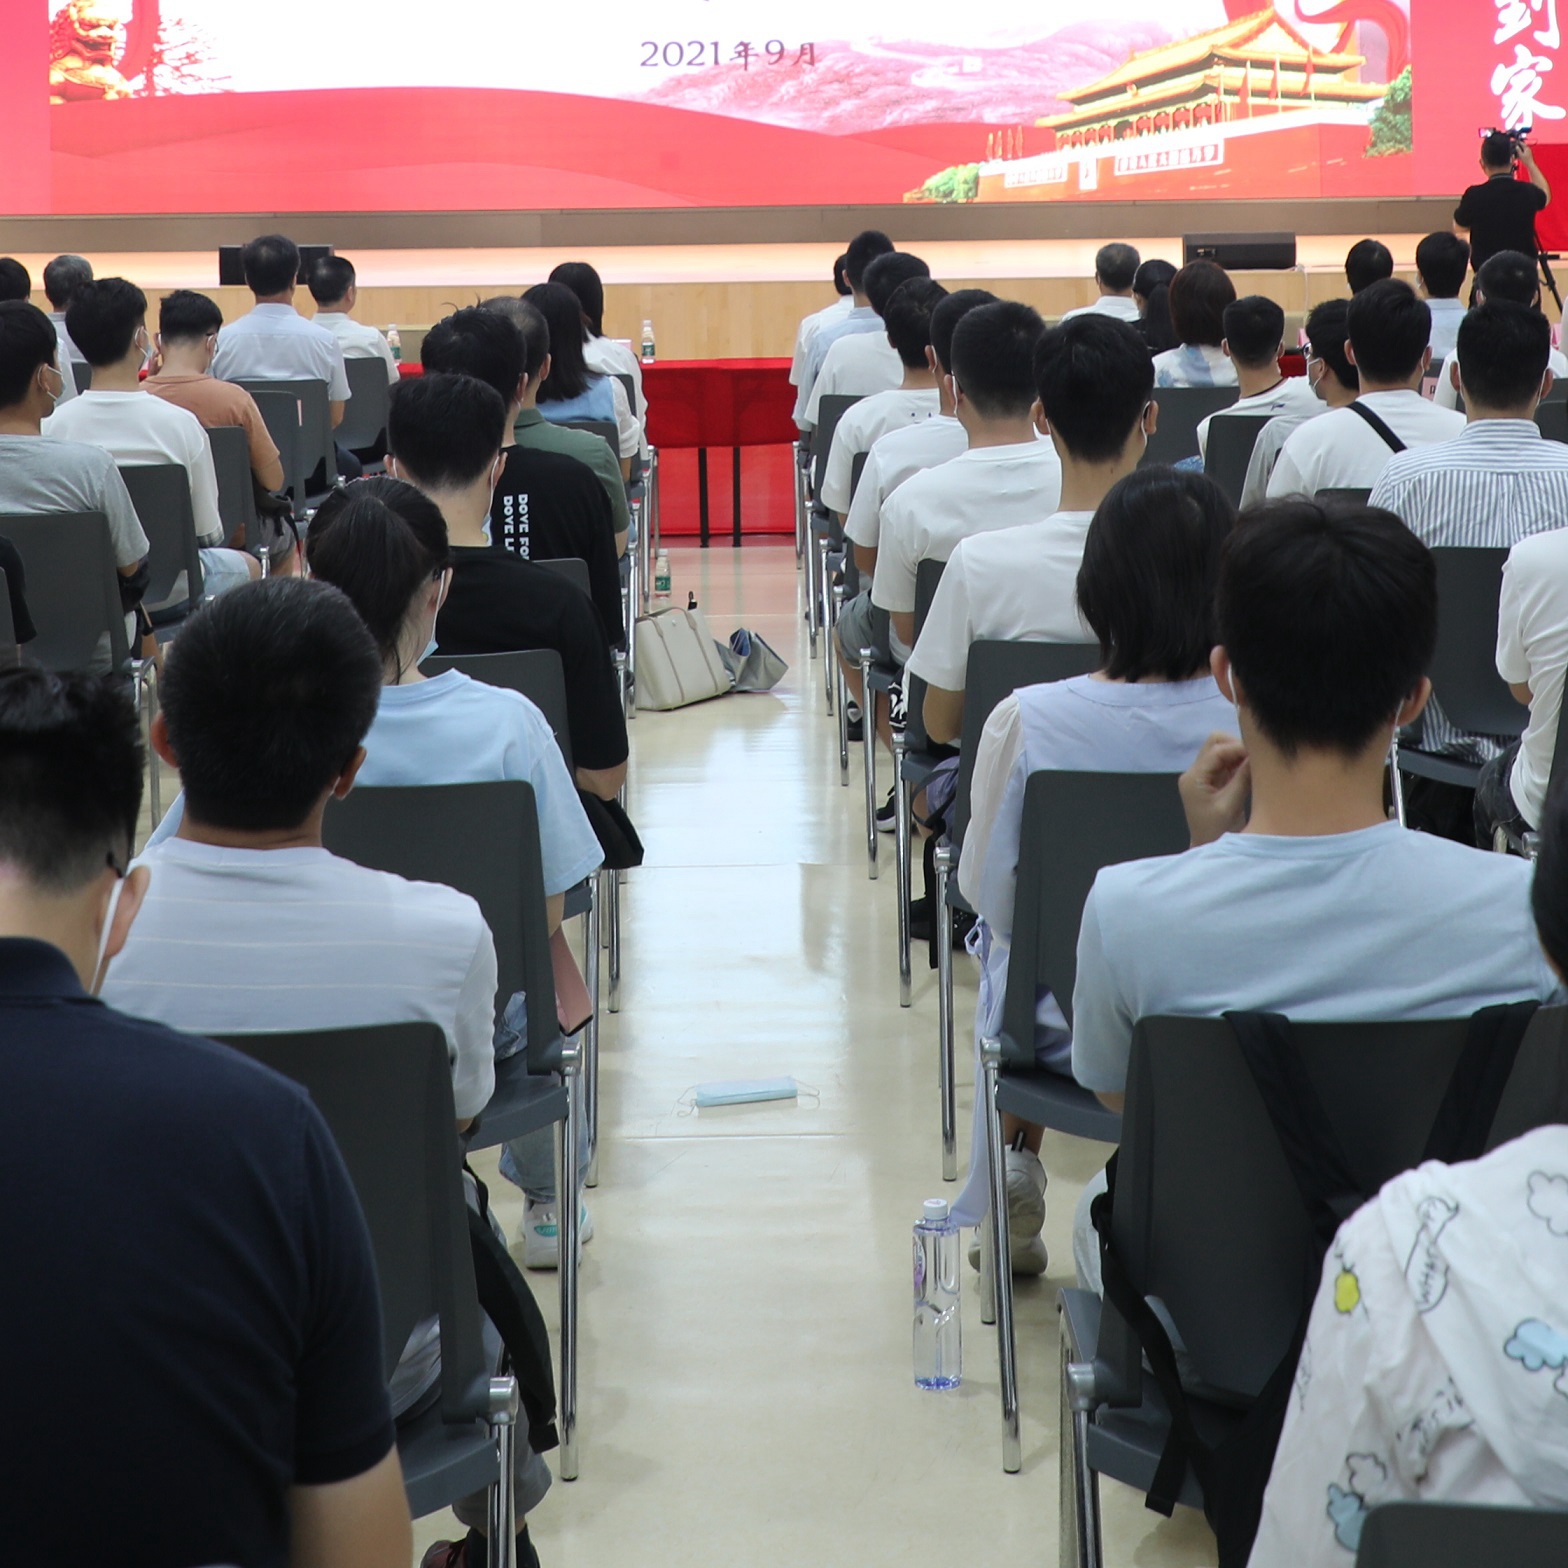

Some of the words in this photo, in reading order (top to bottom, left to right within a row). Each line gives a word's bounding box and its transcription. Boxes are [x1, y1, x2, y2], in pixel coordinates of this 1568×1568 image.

[639, 39, 819, 70] 2021年9月
[503, 495, 514, 534] DOVE
[518, 493, 529, 533] DOVE
